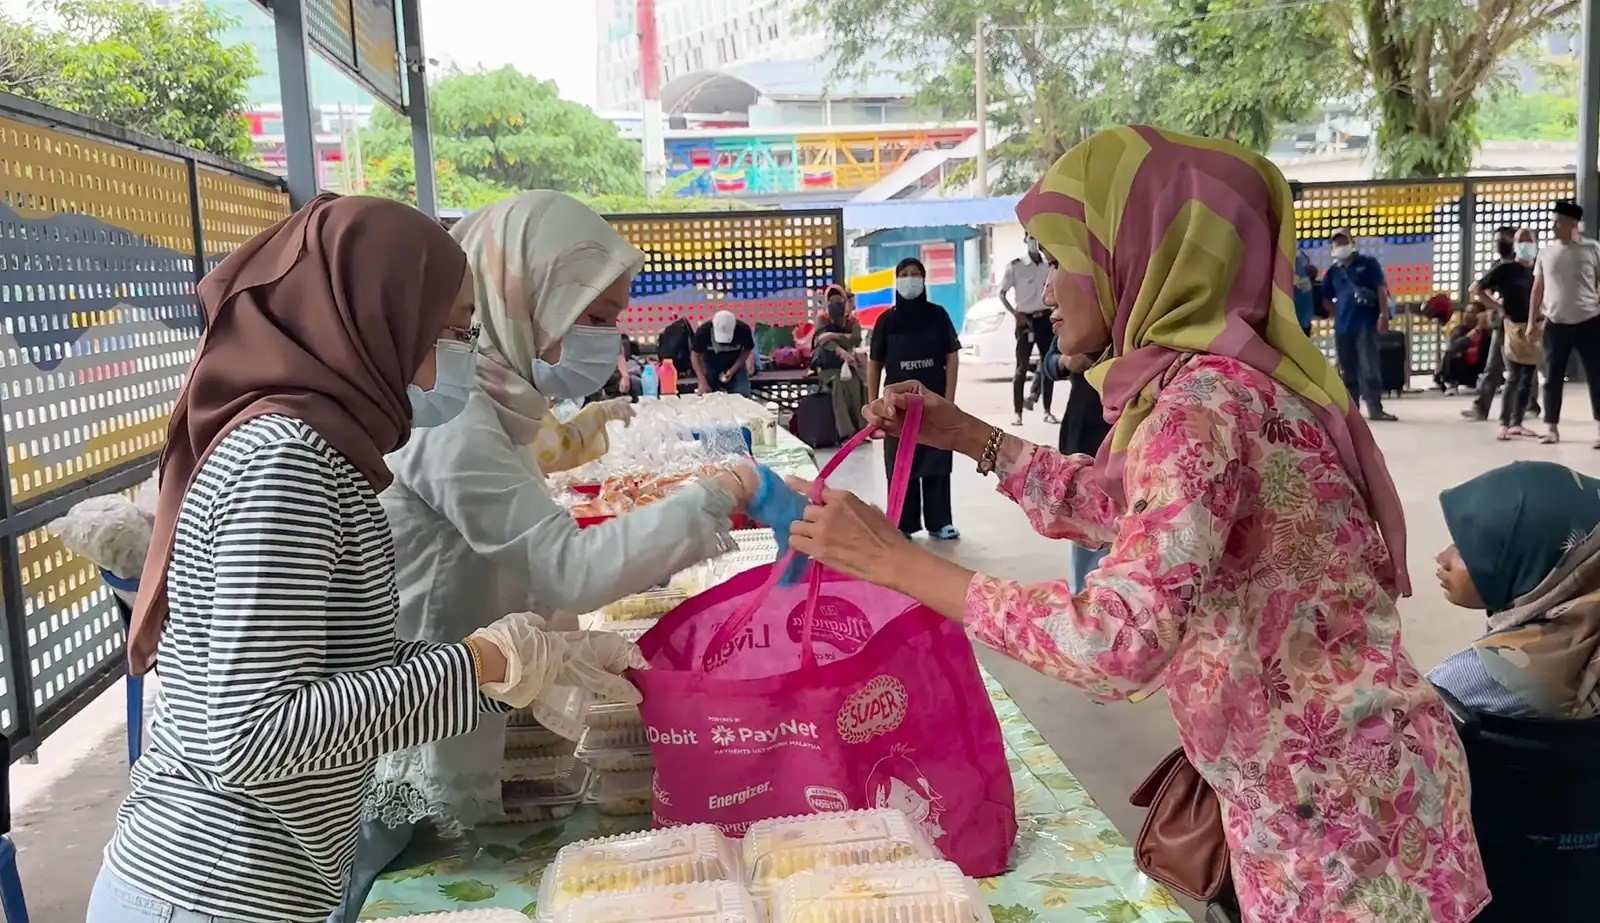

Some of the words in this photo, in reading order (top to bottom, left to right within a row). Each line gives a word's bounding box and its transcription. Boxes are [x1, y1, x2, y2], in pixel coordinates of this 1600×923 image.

[851, 690, 898, 728] SUPER
[647, 725, 699, 745] Debit
[738, 719, 819, 743] PayNet
[708, 781, 771, 809] Energizer
